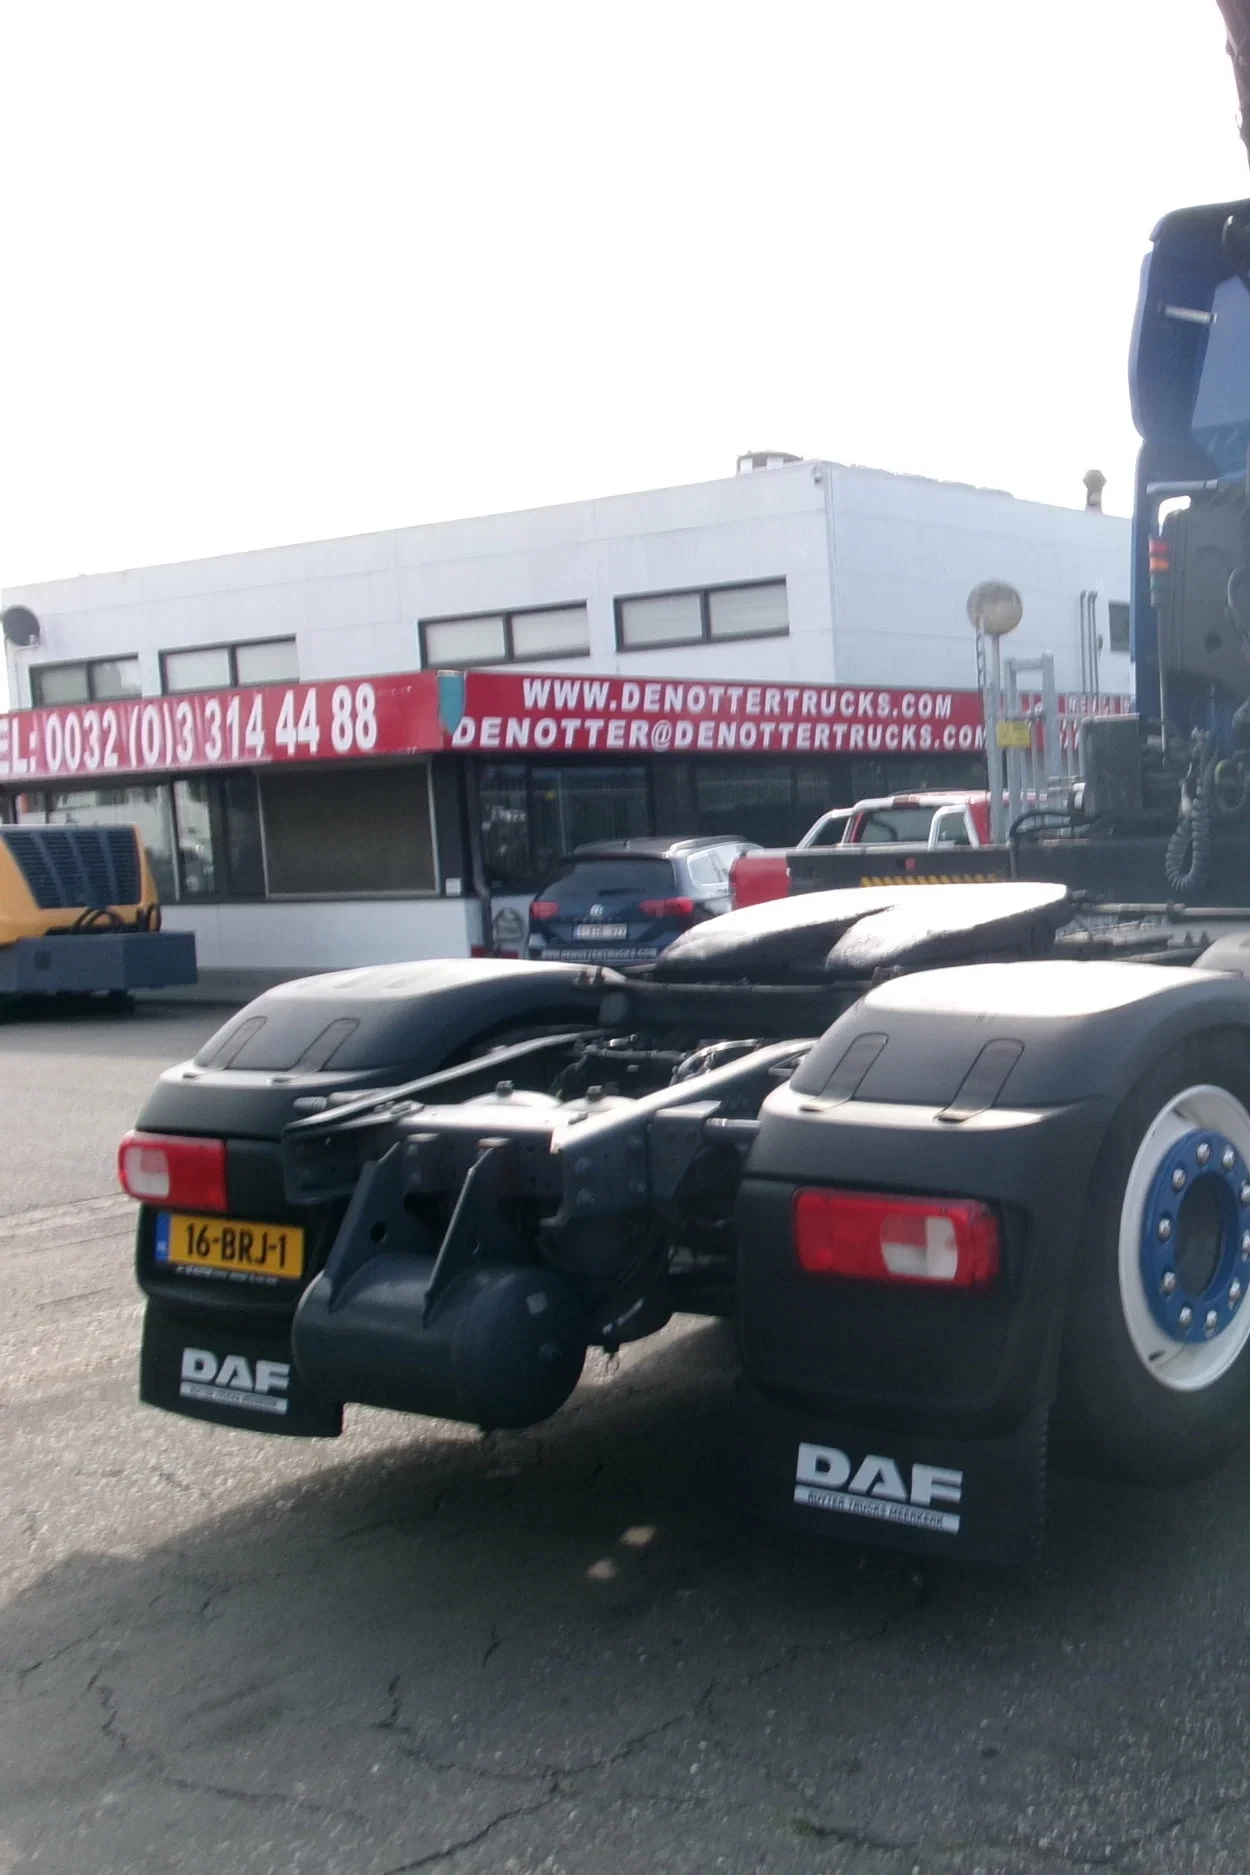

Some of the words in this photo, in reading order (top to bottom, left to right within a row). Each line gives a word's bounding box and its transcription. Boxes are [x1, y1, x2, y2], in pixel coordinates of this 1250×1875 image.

[523, 678, 952, 720] WWW.DENOTTERTRUCKS.COM
[45, 707, 118, 772] 0032
[204, 693, 265, 762] 314
[275, 687, 320, 757] 44
[331, 682, 377, 753] 88
[187, 1222, 287, 1268] 16-BRJ-1
[181, 1346, 291, 1394] DAF
[795, 1442, 963, 1506] DAF
